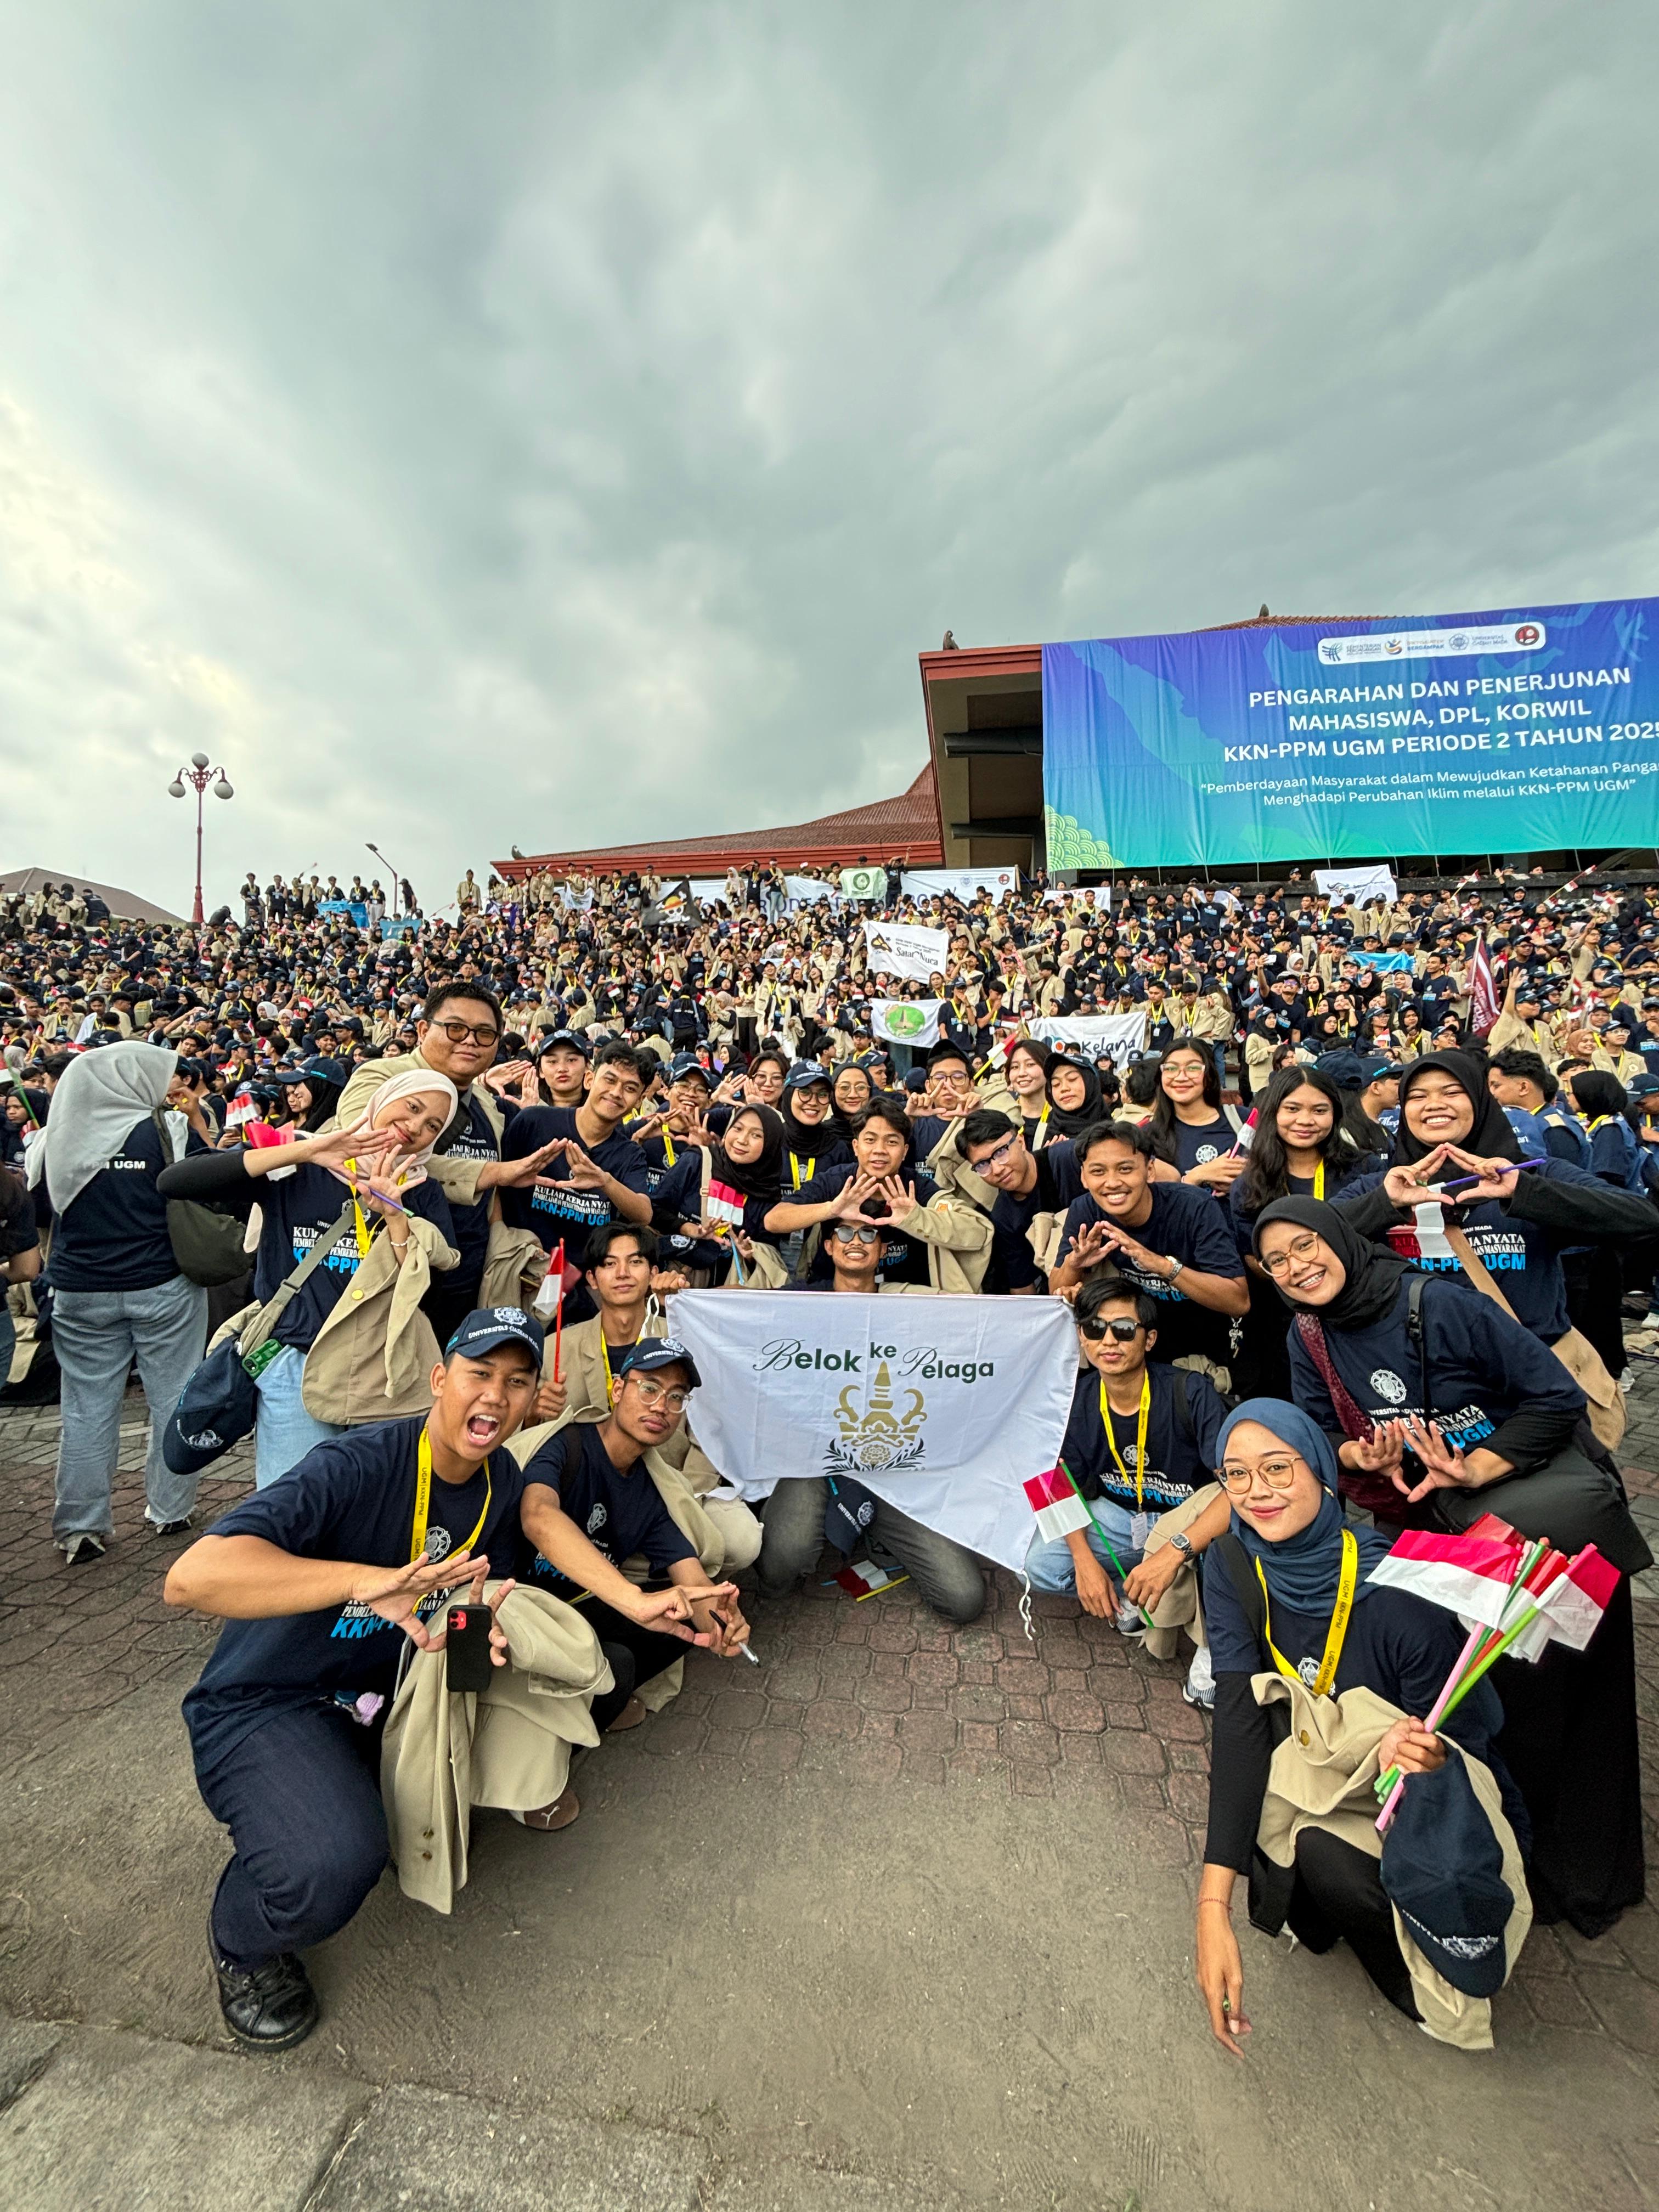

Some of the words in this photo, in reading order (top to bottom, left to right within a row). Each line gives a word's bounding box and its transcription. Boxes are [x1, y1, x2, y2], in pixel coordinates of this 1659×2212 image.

[1250, 684, 1403, 708] PENGARAHAN
[1410, 680, 1459, 698] DAN
[1466, 667, 1631, 696] PENERJUNAN
[1289, 709, 1434, 731] MAHASISWA,
[1440, 706, 1491, 726] DPL,
[1497, 699, 1592, 721] KORWIL
[1224, 741, 1327, 762] KKN-PPM
[1333, 739, 1385, 757] UGM
[1392, 733, 1492, 754] PERIODE
[1497, 732, 1510, 748] 2
[1515, 726, 1602, 747] TAHUN
[1201, 776, 1307, 794] “Pemberdayaan
[1311, 772, 1386, 788] Masyarakat
[1390, 772, 1433, 785] dalam
[1437, 769, 1526, 784] Mewujudkan
[1530, 764, 1608, 778] Ketahanan
[1612, 761, 1659, 775] Panga
[1263, 792, 1345, 806] Menghadapi
[1349, 789, 1424, 803] Perubahan
[1428, 788, 1459, 799] Iklim
[1463, 786, 1515, 799] melalui
[1519, 782, 1589, 796] KKN-PPM
[1594, 779, 1636, 792] UGM”
[1081, 1037, 1135, 1054] Kelana
[114, 1160, 145, 1169] UGM
[534, 1185, 565, 1200] KULIAH
[566, 1194, 590, 1207] KERJA
[591, 1200, 611, 1209] NYAT
[531, 1198, 585, 1223] KKN-PPM
[588, 1214, 611, 1226] UGM
[1483, 1234, 1525, 1245] NYATA
[1485, 1244, 1526, 1254] MASYARAKAT
[1484, 1254, 1526, 1271] UGM
[469, 1325, 508, 1339] UNIVERSITAS
[753, 1338, 863, 1373] Belok
[870, 1342, 897, 1358] ke
[898, 1347, 994, 1384] Pelaga
[1446, 1419, 1496, 1449] UGM
[1105, 1483, 1163, 1504] KKN-PM
[1165, 1496, 1185, 1505] UG
[1162, 1481, 1194, 1492] NYATA
[418, 1487, 426, 1516] KKN-PPM
[1342, 1580, 1351, 1598] UGM
[1335, 1601, 1347, 1629] KKN-PPM
[1327, 1650, 1335, 1667] UGM
